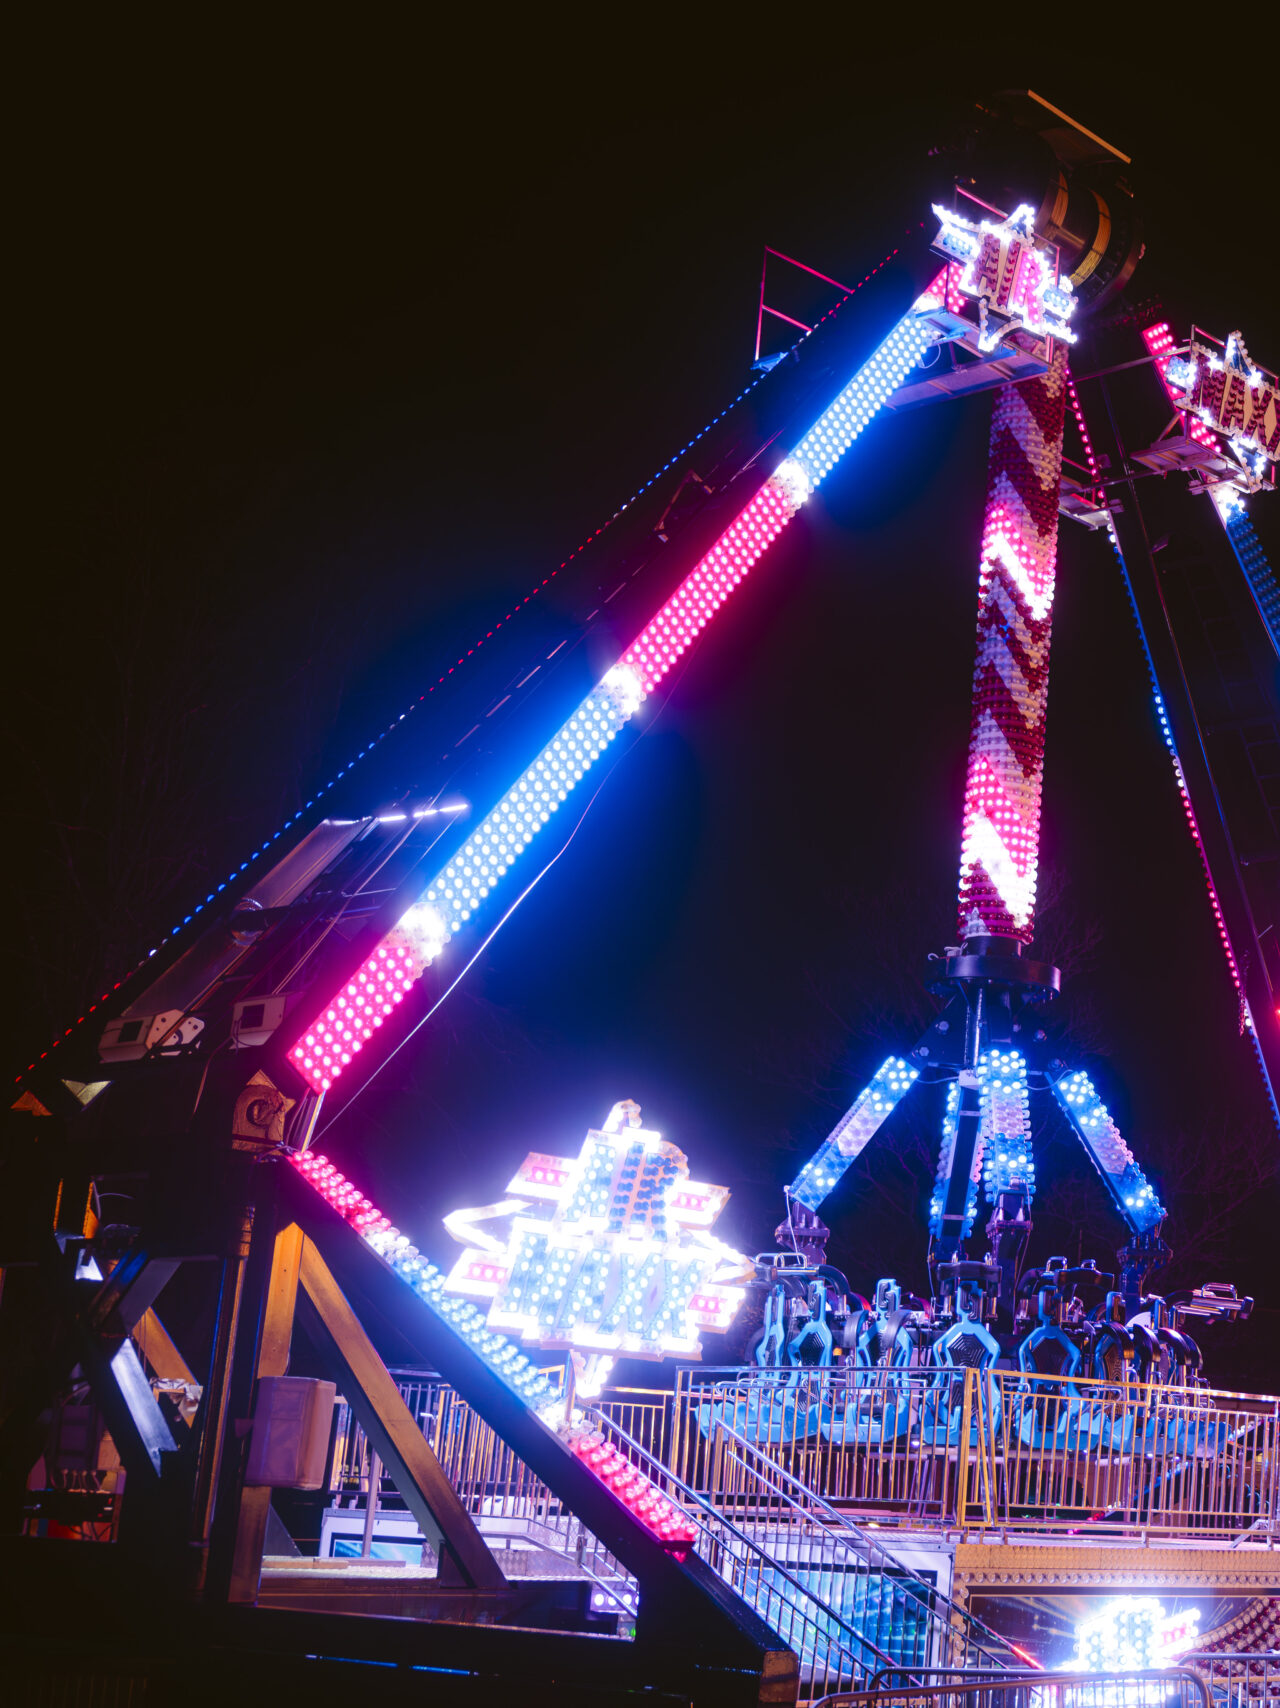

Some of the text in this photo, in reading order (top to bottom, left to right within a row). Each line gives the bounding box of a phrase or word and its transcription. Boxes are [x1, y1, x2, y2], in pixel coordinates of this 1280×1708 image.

[969, 232, 1046, 325] AIR
[562, 1141, 680, 1243] AIR
[500, 1230, 706, 1341] MAXX
